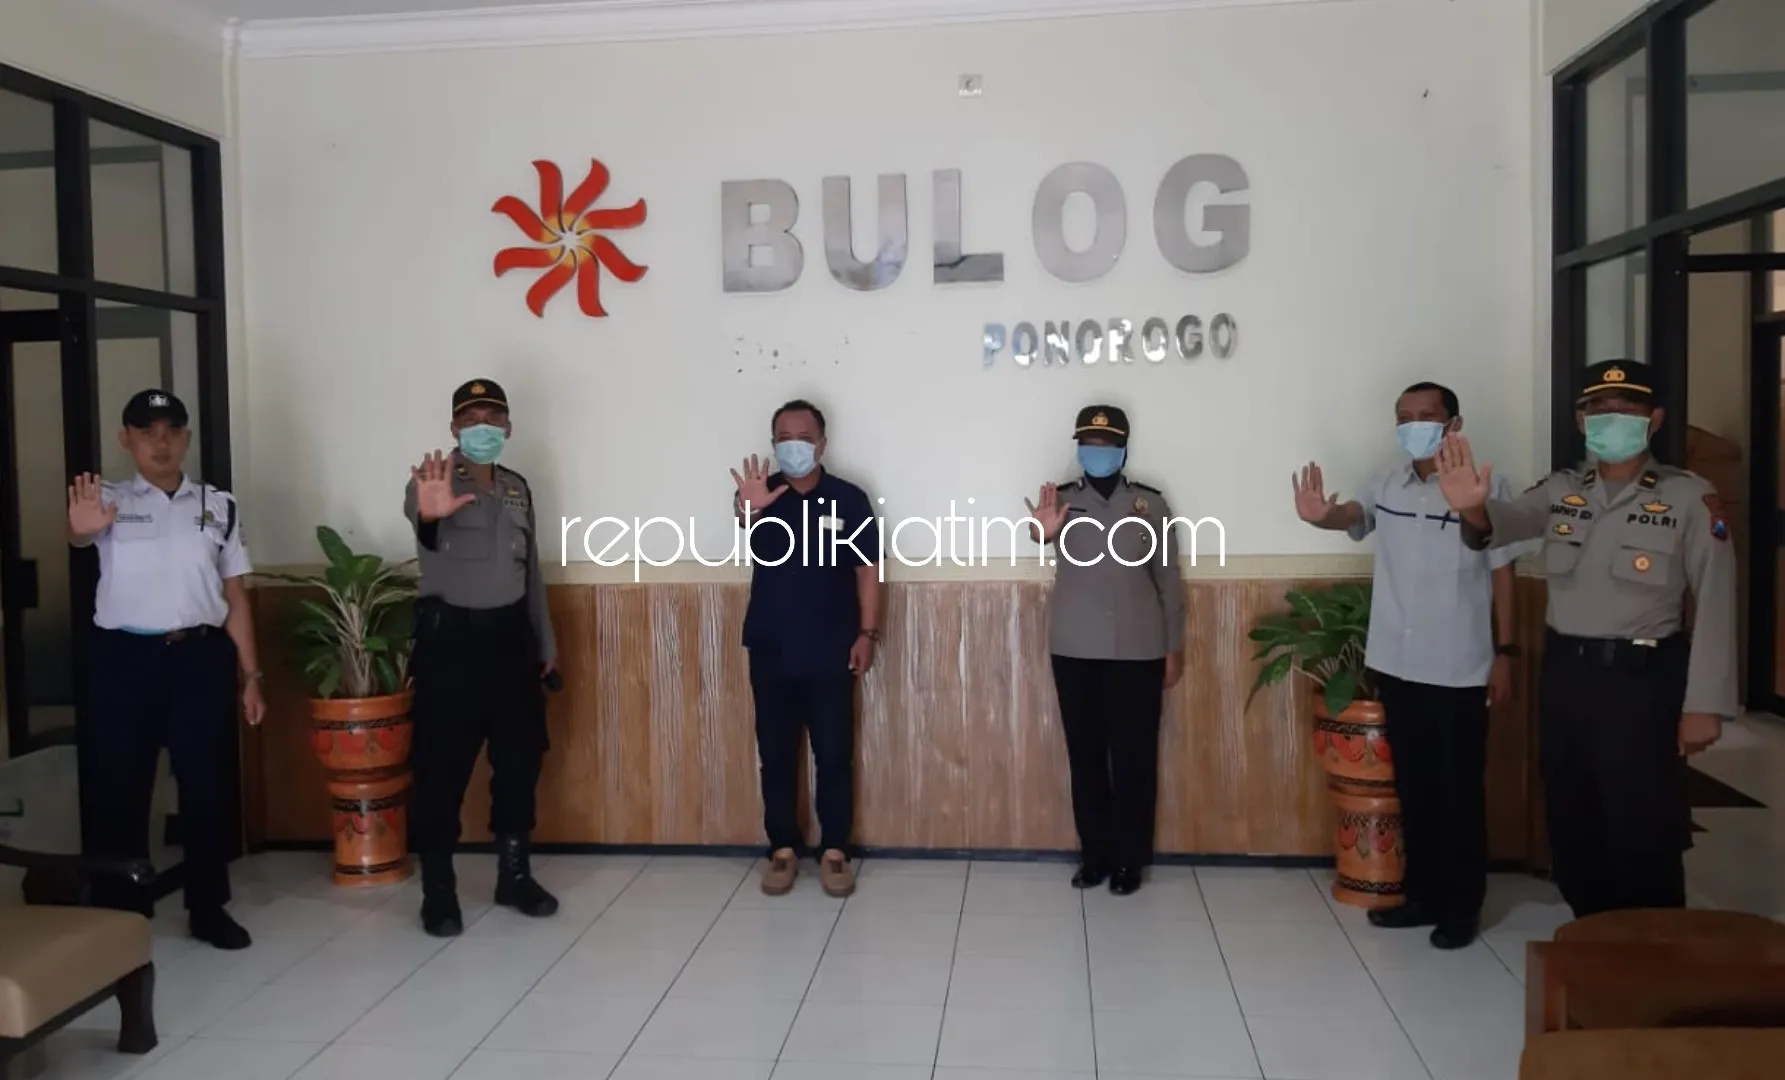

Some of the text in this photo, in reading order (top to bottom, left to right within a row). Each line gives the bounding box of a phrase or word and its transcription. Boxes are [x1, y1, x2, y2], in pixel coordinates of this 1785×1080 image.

[720, 153, 1252, 292] BULOG
[982, 312, 1238, 369] PONOROGO
[1626, 513, 1678, 528] POLRI
